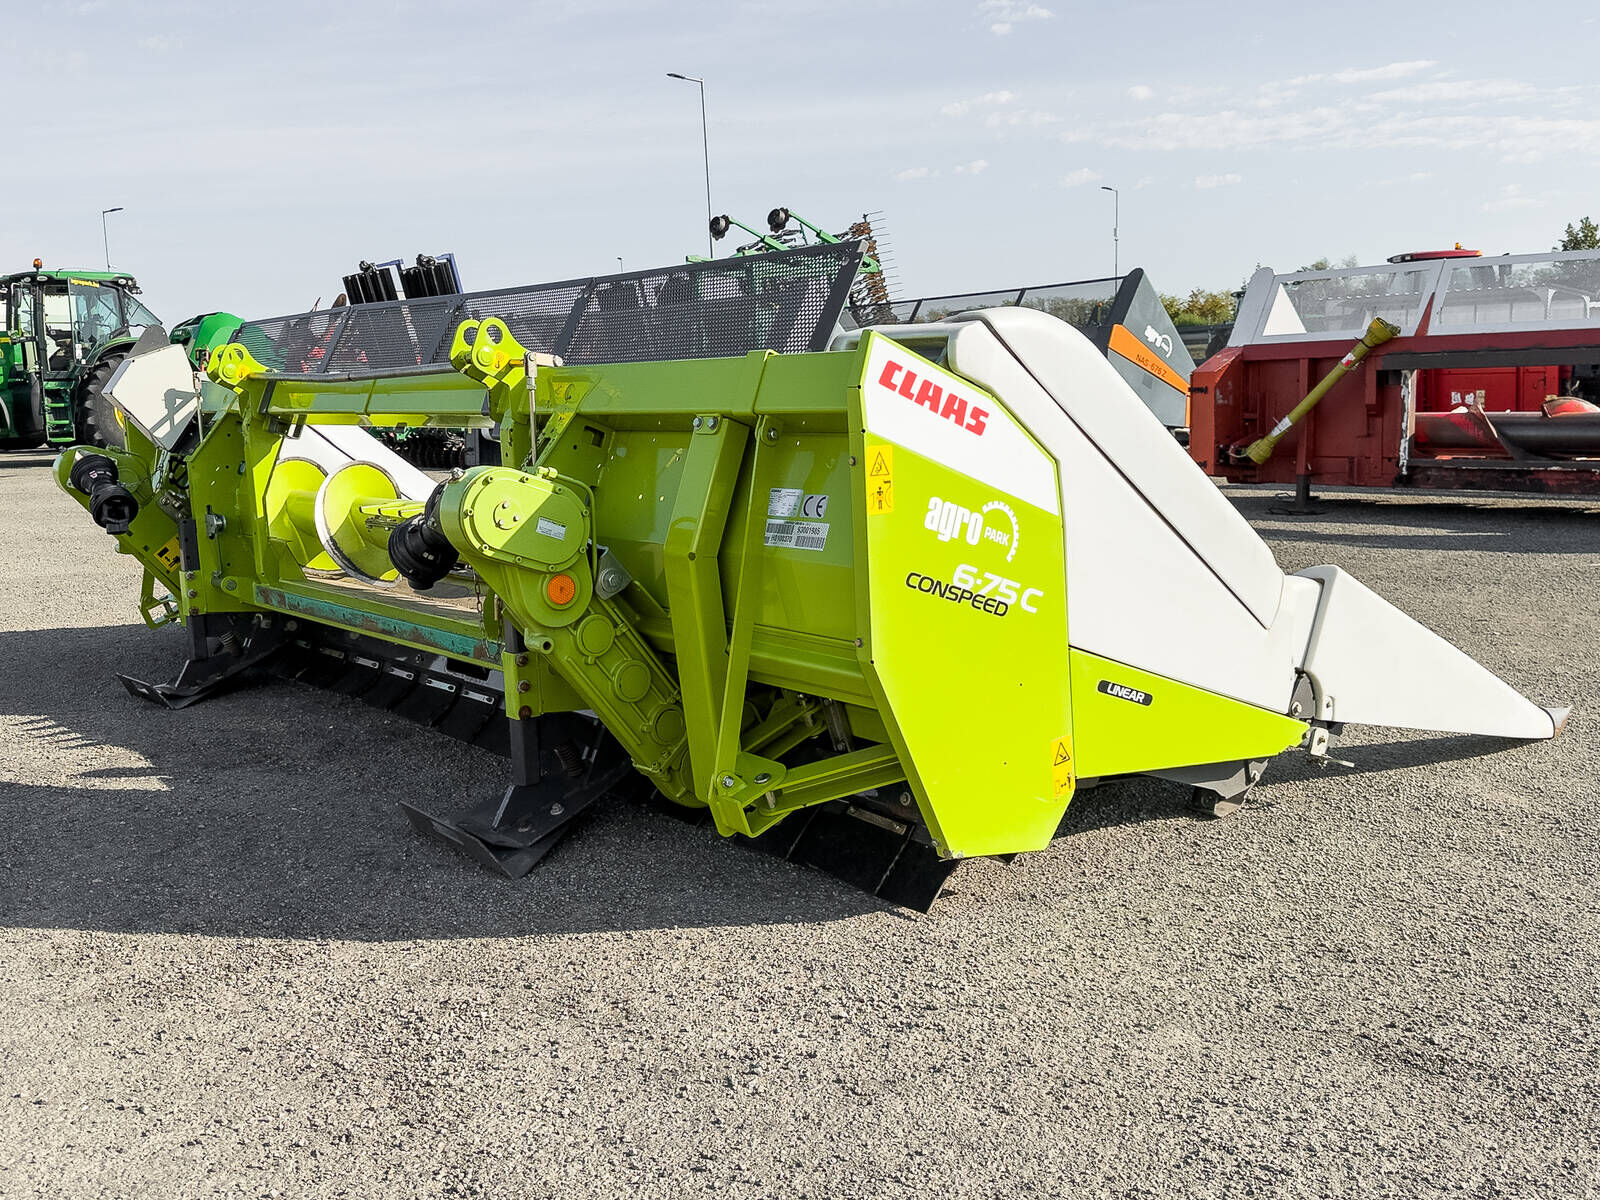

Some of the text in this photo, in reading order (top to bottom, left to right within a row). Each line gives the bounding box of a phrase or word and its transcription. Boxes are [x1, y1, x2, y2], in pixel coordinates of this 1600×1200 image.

[878, 360, 990, 436] CLAAS
[924, 496, 984, 546] agro
[983, 526, 1010, 546] PARK
[905, 572, 1009, 617] CONSPEED
[1106, 682, 1146, 703] LINEAR
